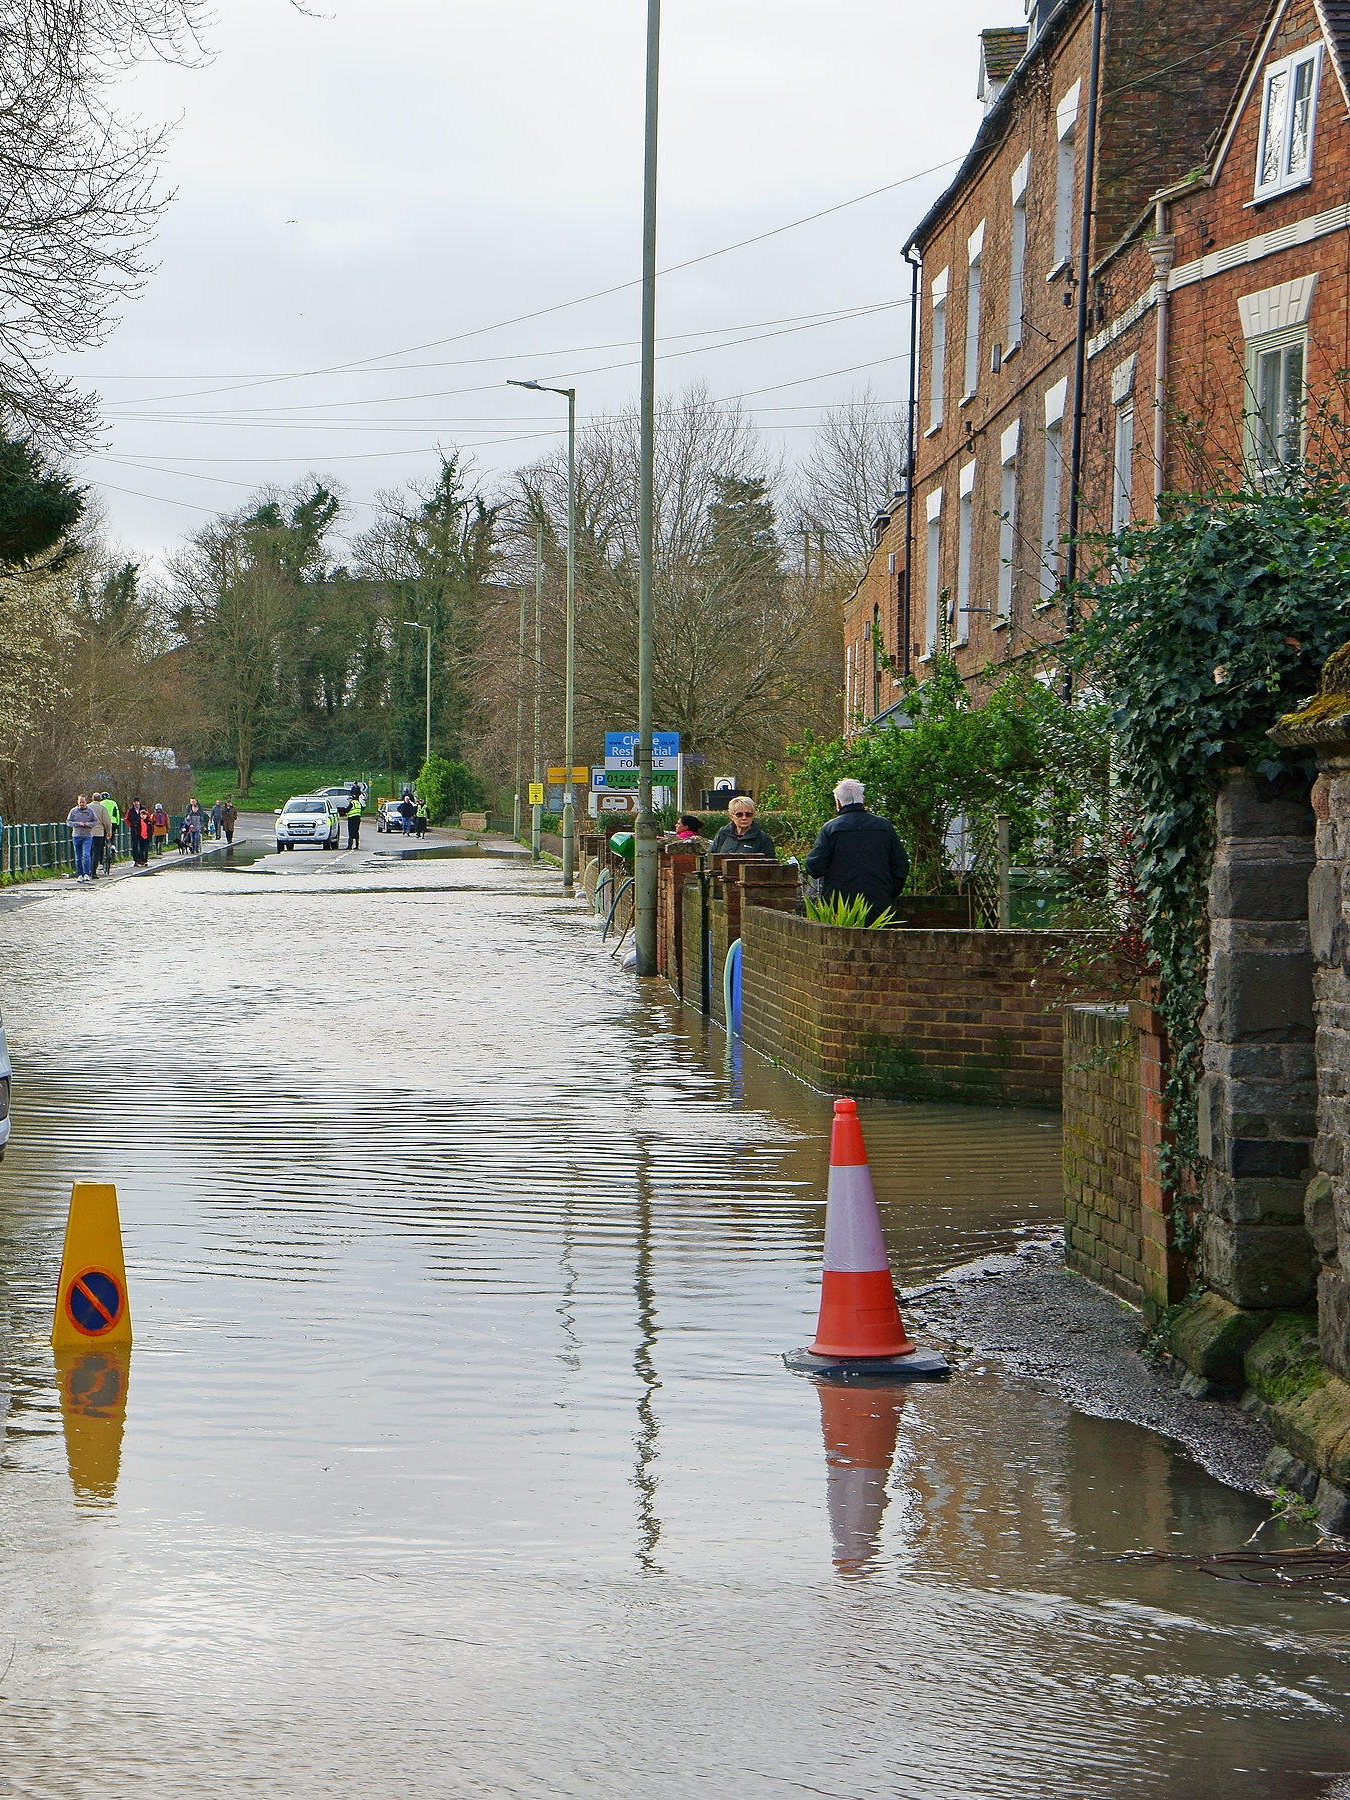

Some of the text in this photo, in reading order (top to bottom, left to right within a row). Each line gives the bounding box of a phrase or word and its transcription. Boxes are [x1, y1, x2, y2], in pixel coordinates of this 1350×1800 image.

[623, 735, 660, 746] Clee
[612, 746, 671, 756] Resitial
[596, 776, 604, 785] P
